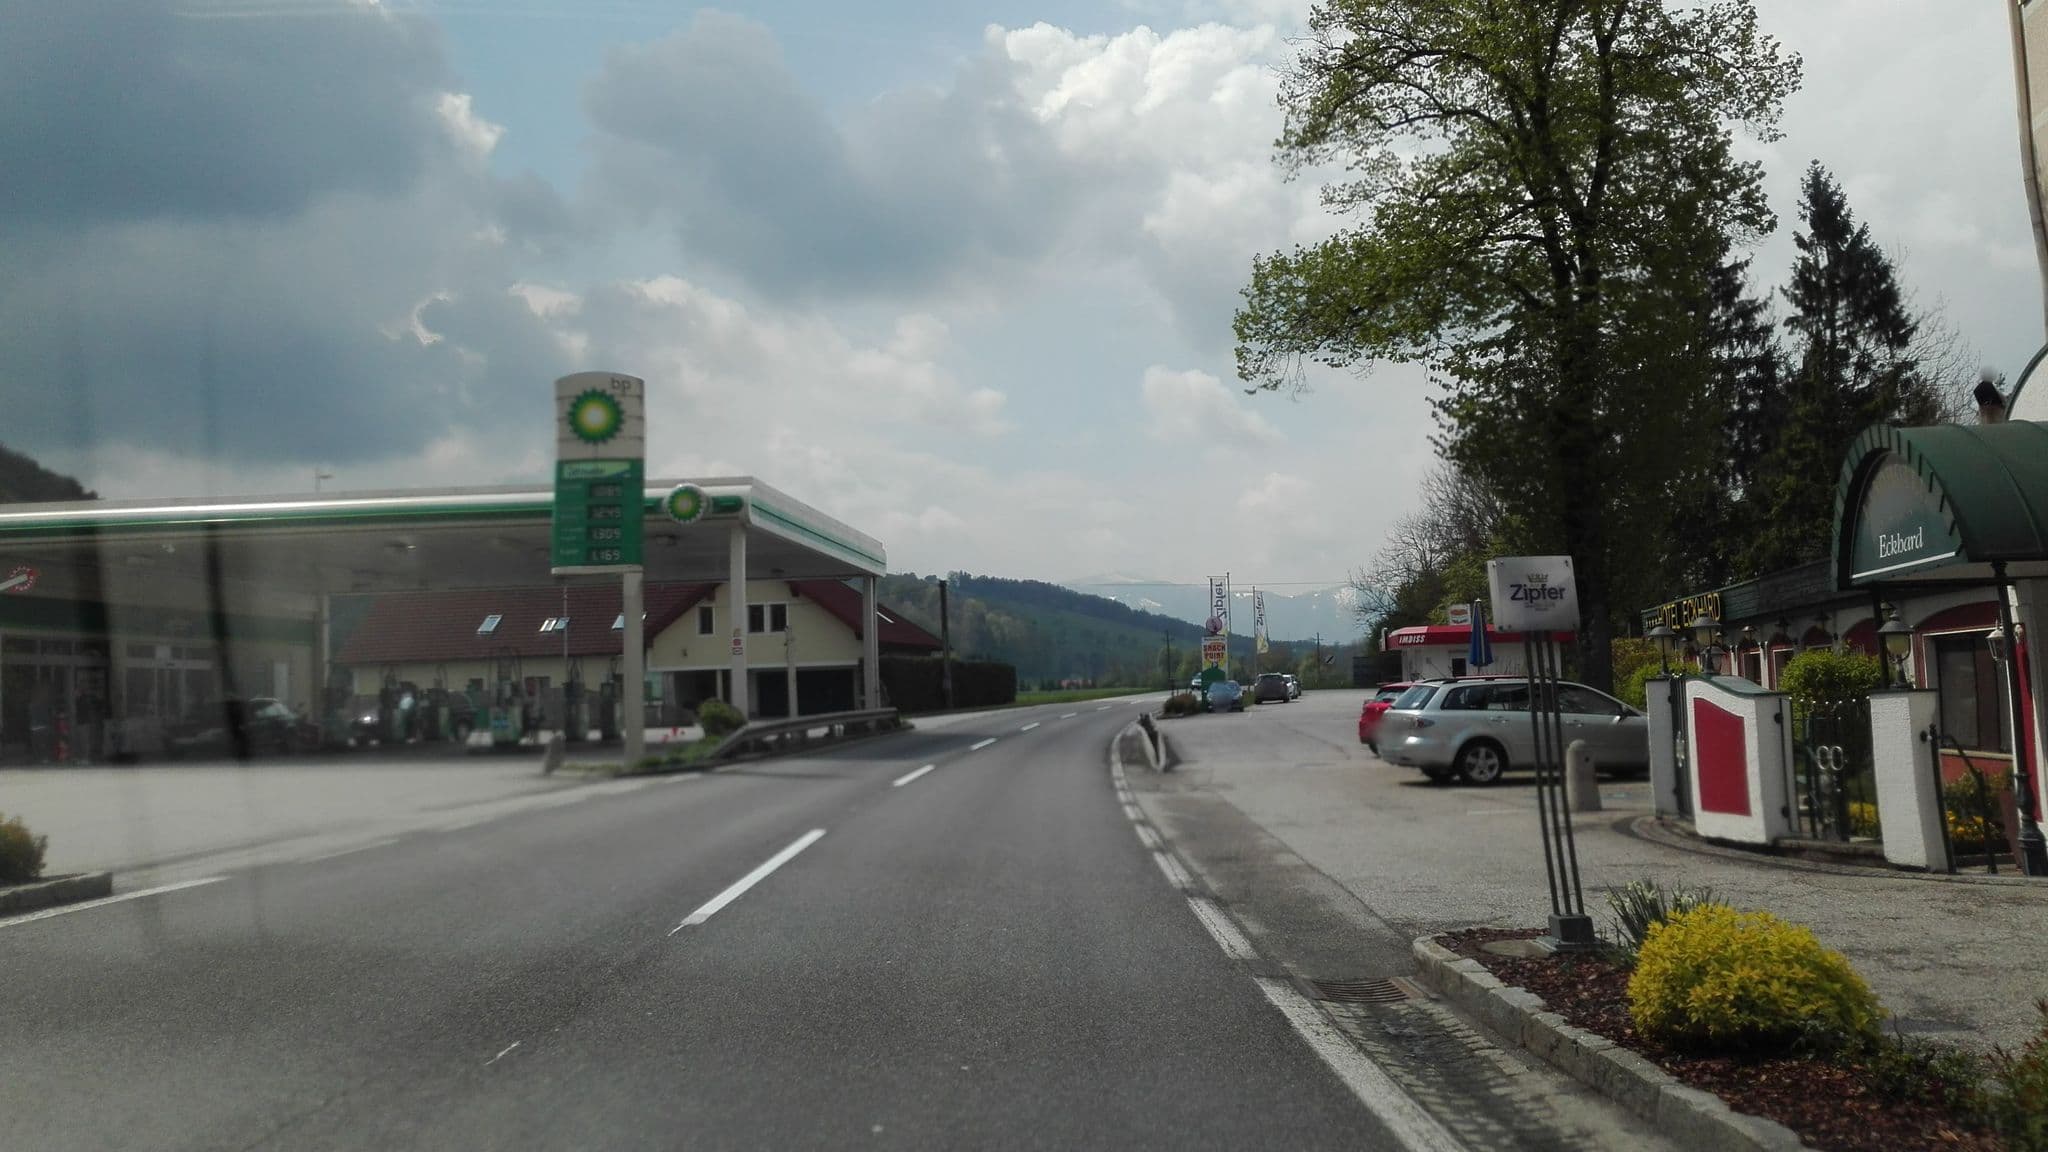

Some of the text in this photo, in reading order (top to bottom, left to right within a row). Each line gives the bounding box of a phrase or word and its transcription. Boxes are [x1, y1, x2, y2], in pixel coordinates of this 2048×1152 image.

[611, 377, 631, 392] bp
[1879, 526, 1923, 558] Eckhard
[1510, 584, 1566, 604] Zipfer
[1657, 592, 1720, 631] HOTEL ECKHARD
[1399, 635, 1426, 645] IMBISS
